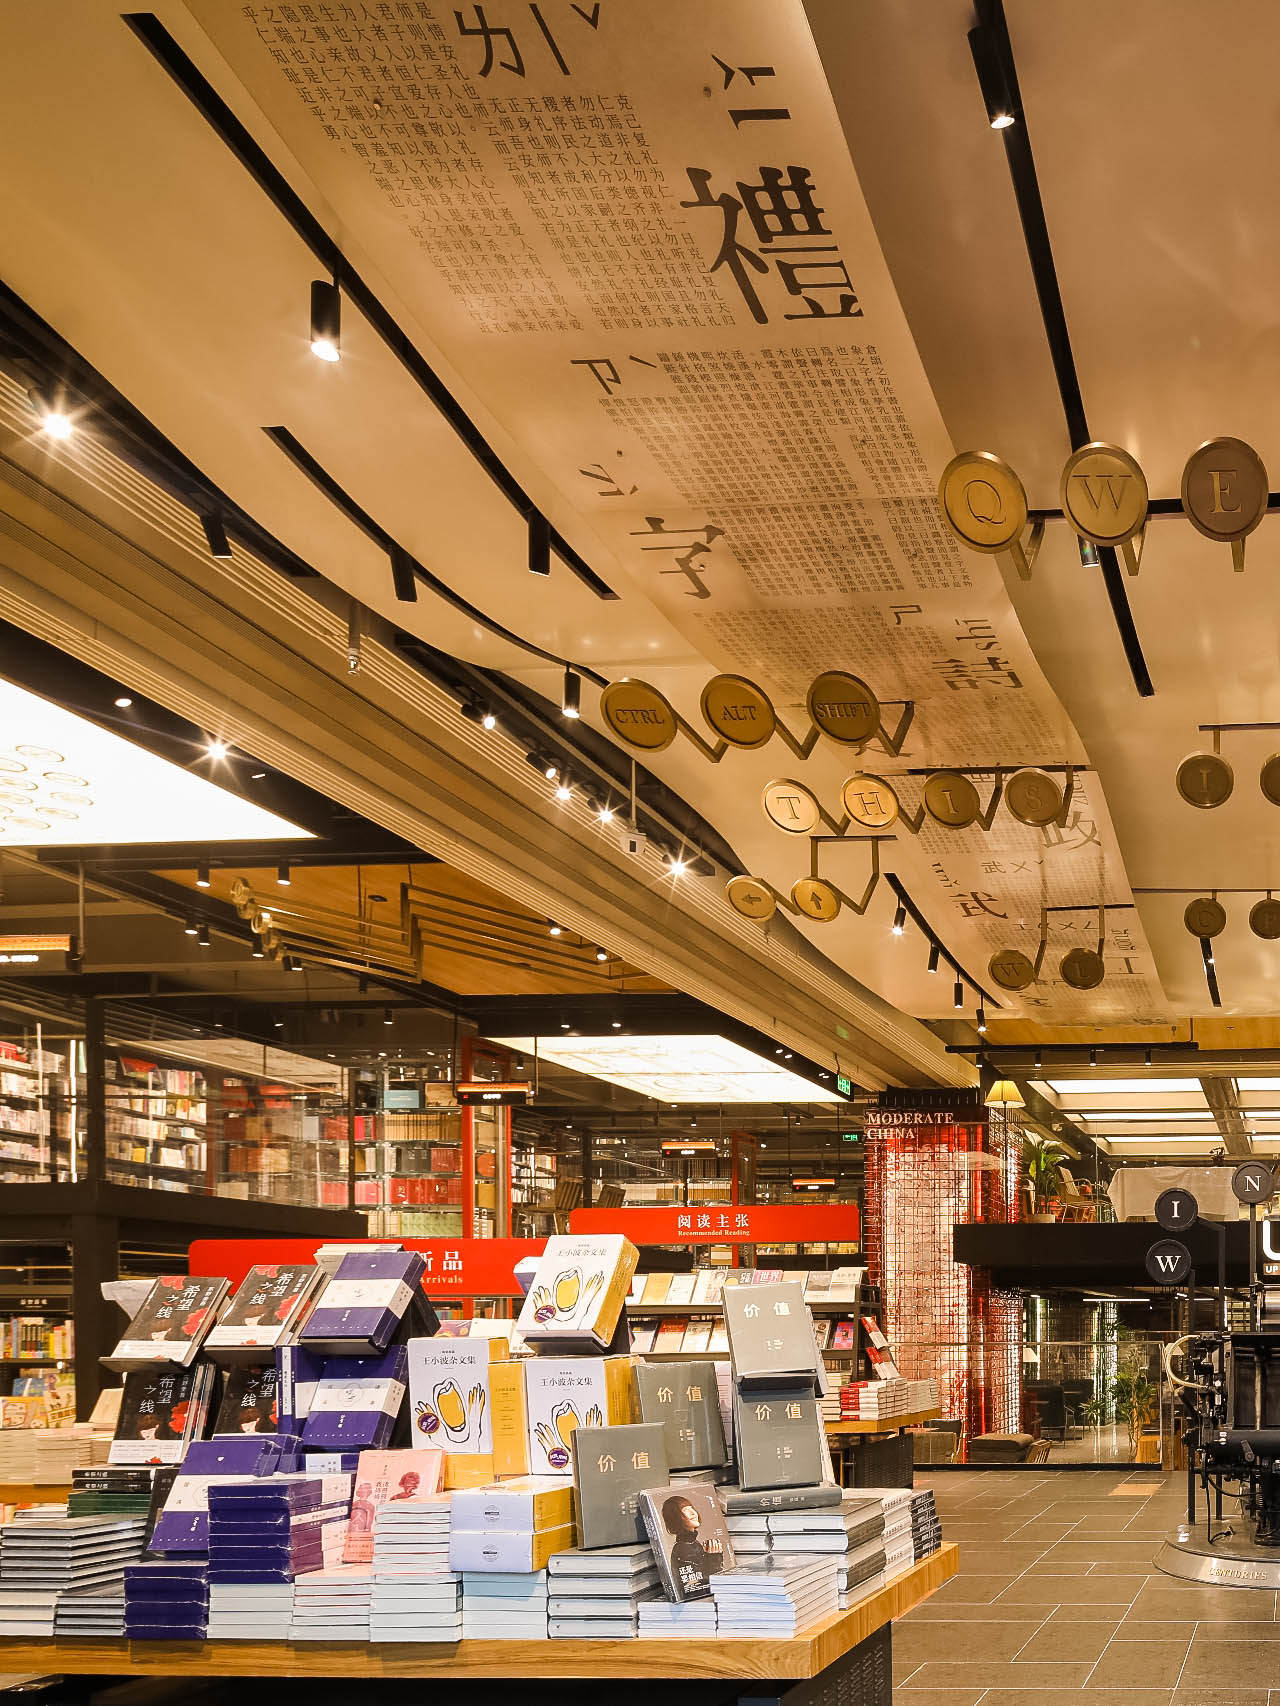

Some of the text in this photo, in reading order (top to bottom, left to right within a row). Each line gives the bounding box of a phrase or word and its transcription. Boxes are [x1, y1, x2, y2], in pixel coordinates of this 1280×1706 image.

[680, 164, 864, 324] 禮
[615, 701, 871, 725] CTRL ALT SHIFT
[867, 1112, 953, 1124] MODERATE
[866, 1127, 916, 1140] CHINA
[678, 1214, 749, 1228] 阅读主张
[760, 1271, 780, 1282] 世界
[1265, 1265, 1278, 1273] UP
[744, 1301, 791, 1319] 价值
[657, 1385, 704, 1403] 价值
[755, 1402, 802, 1421] 价值
[597, 1451, 651, 1473] 价值
